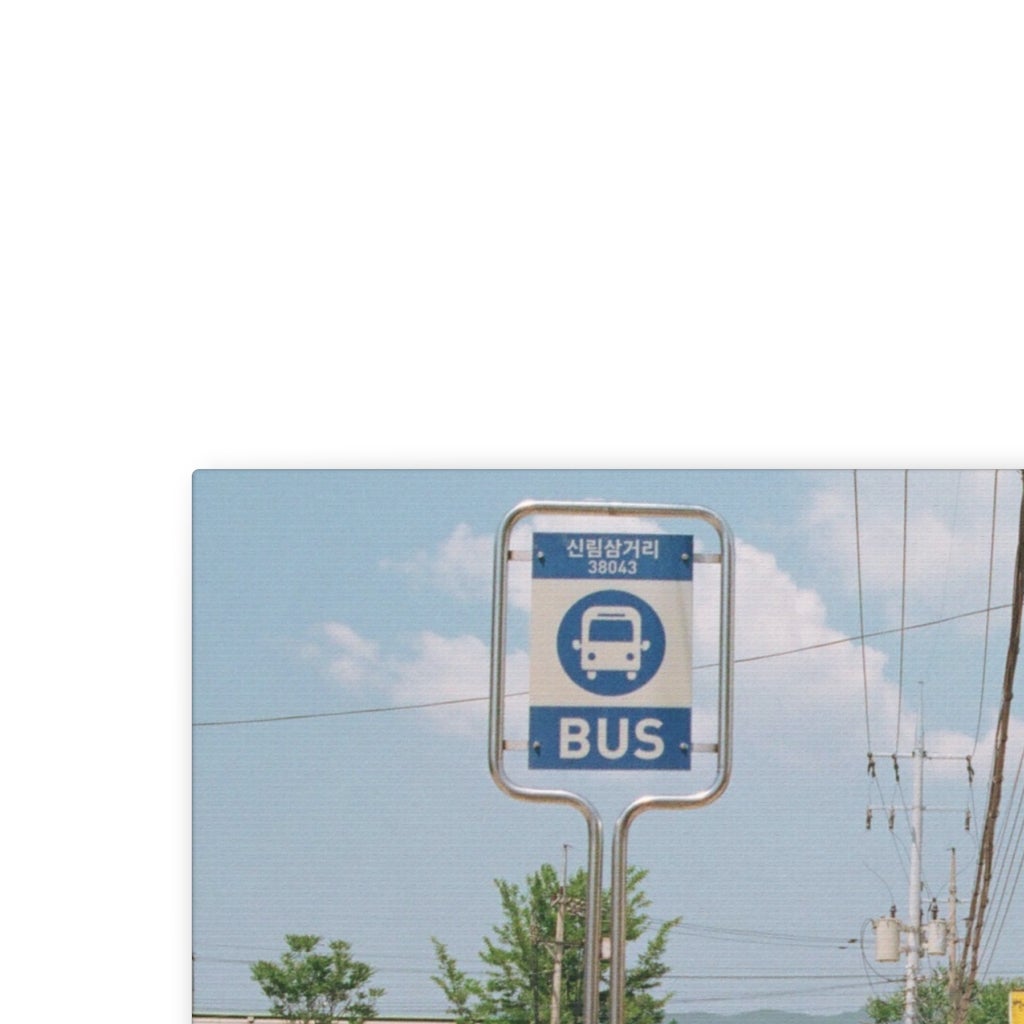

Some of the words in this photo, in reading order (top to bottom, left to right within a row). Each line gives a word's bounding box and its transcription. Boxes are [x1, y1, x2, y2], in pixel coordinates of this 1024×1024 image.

[566, 538, 660, 559] 신림삼거리
[588, 560, 637, 575] 38043
[559, 717, 665, 760] BUS
